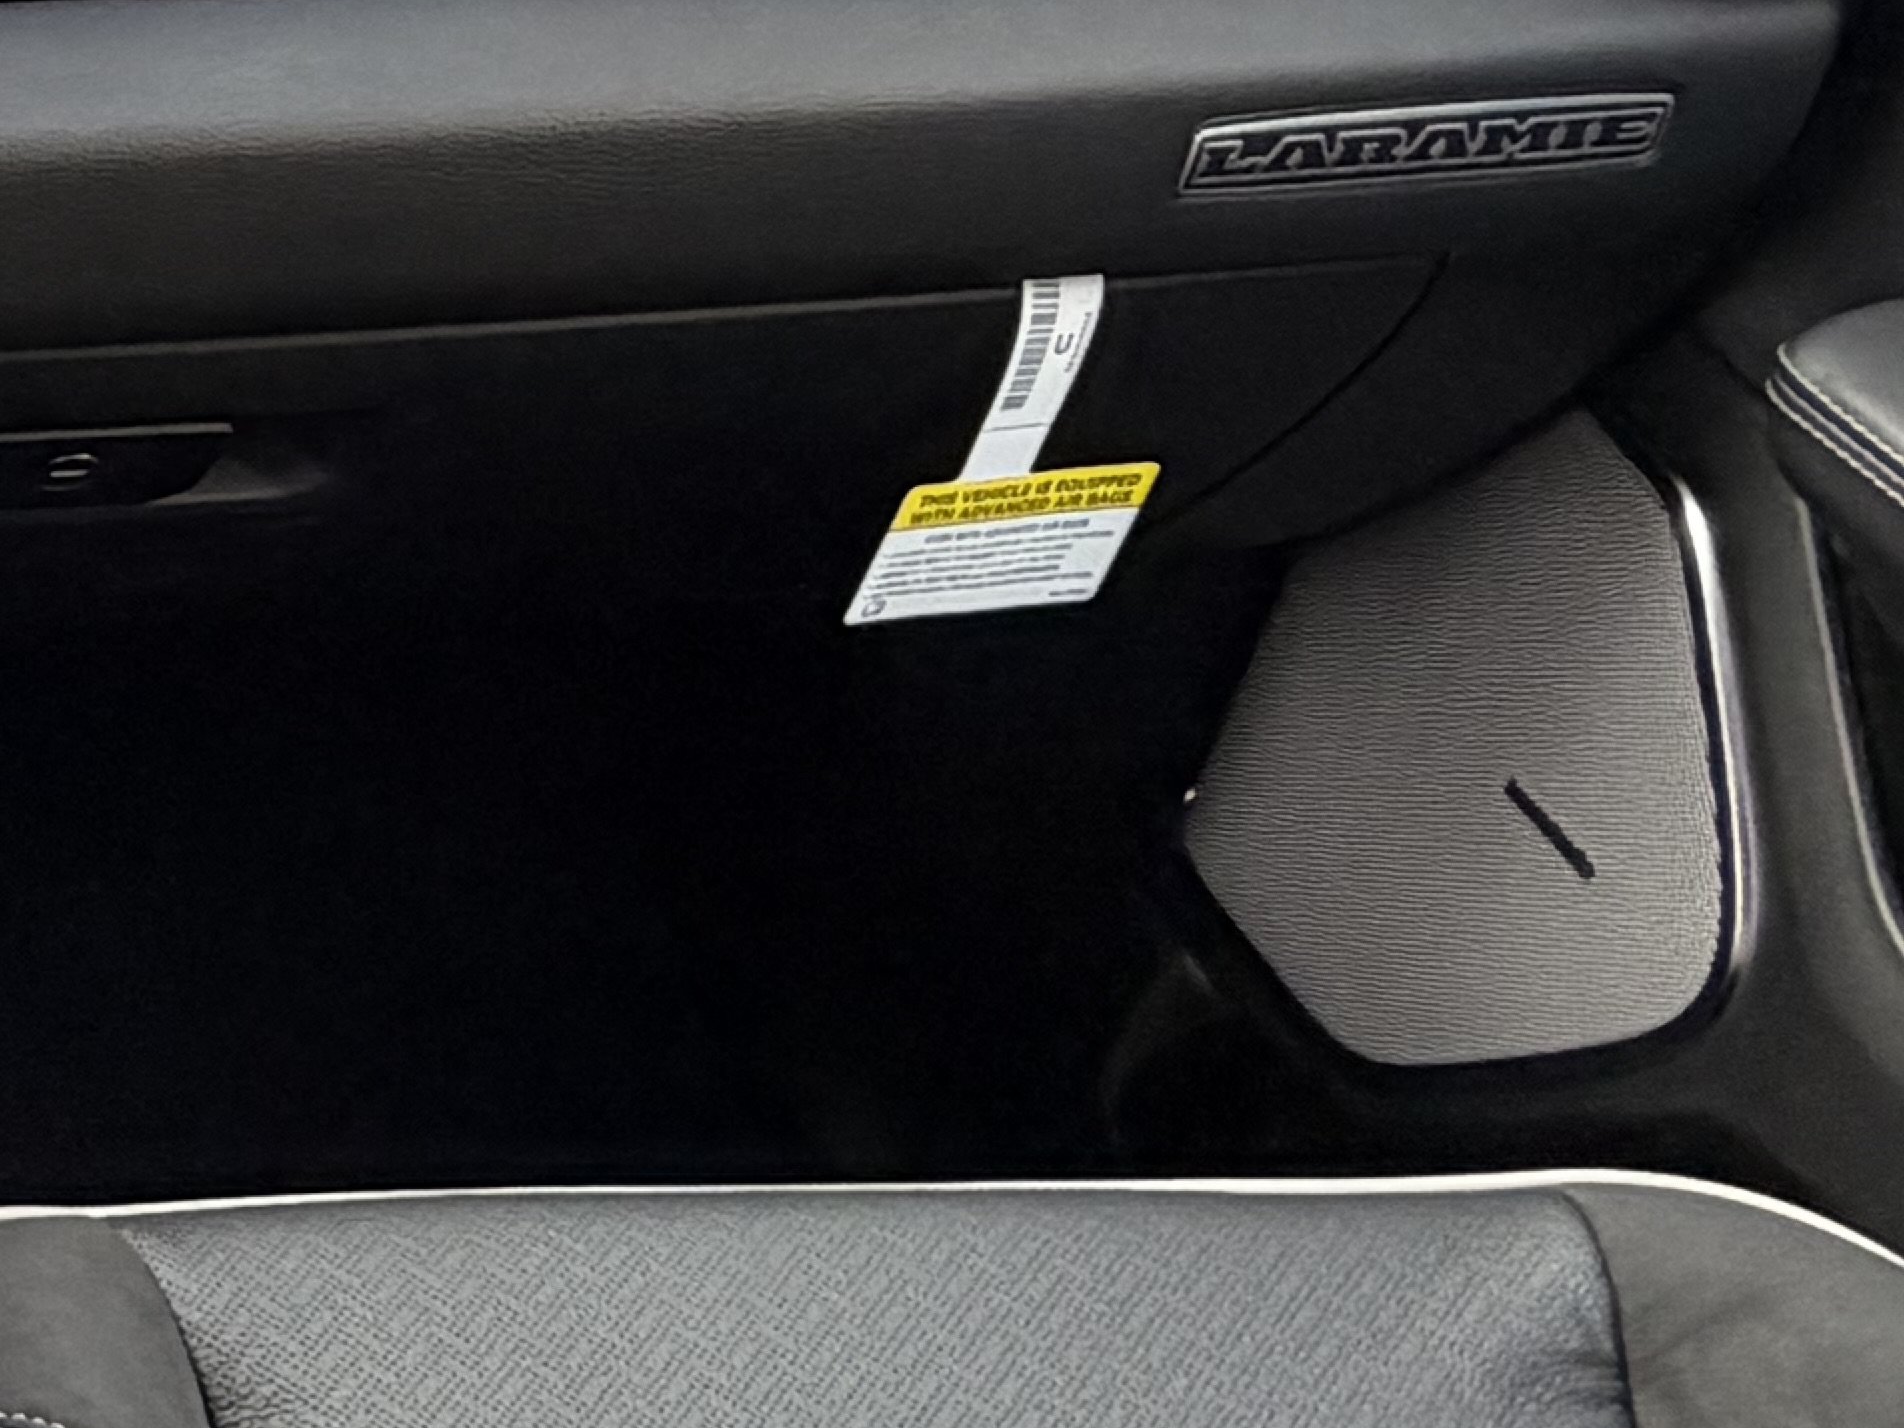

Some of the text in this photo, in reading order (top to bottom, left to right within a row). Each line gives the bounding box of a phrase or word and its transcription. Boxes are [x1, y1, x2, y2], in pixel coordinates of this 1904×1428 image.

[1195, 107, 1664, 184] LARAMIE
[962, 479, 1032, 504] VEHICLE
[1054, 473, 1144, 494] EQUIPPED
[957, 496, 1051, 520] ADVANCED
[1054, 492, 1081, 509] AIR
[1085, 489, 1136, 506] BAGS
